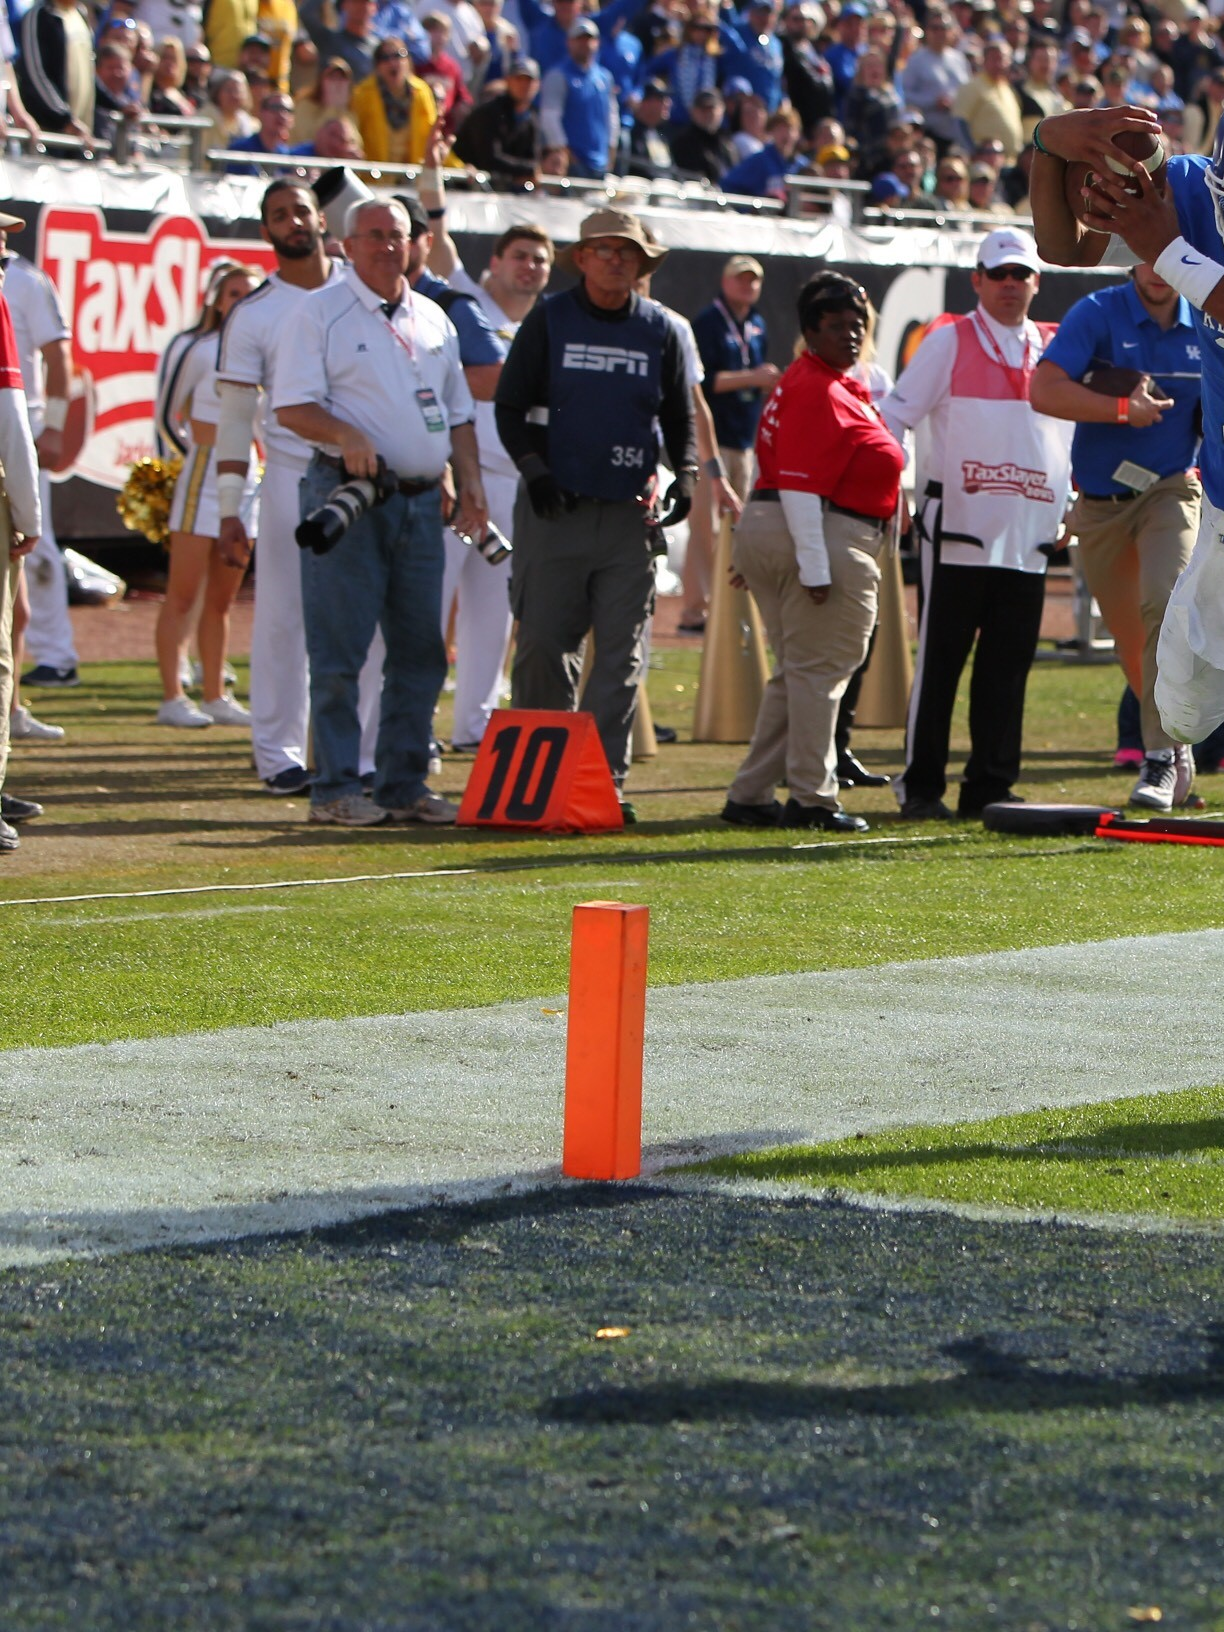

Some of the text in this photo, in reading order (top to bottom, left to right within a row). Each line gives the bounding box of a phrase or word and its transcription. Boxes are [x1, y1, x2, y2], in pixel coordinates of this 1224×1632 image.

[563, 343, 649, 377] ESPN
[611, 446, 645, 469] 354
[963, 463, 1047, 490] TaxSlayer
[476, 726, 570, 822] 10
